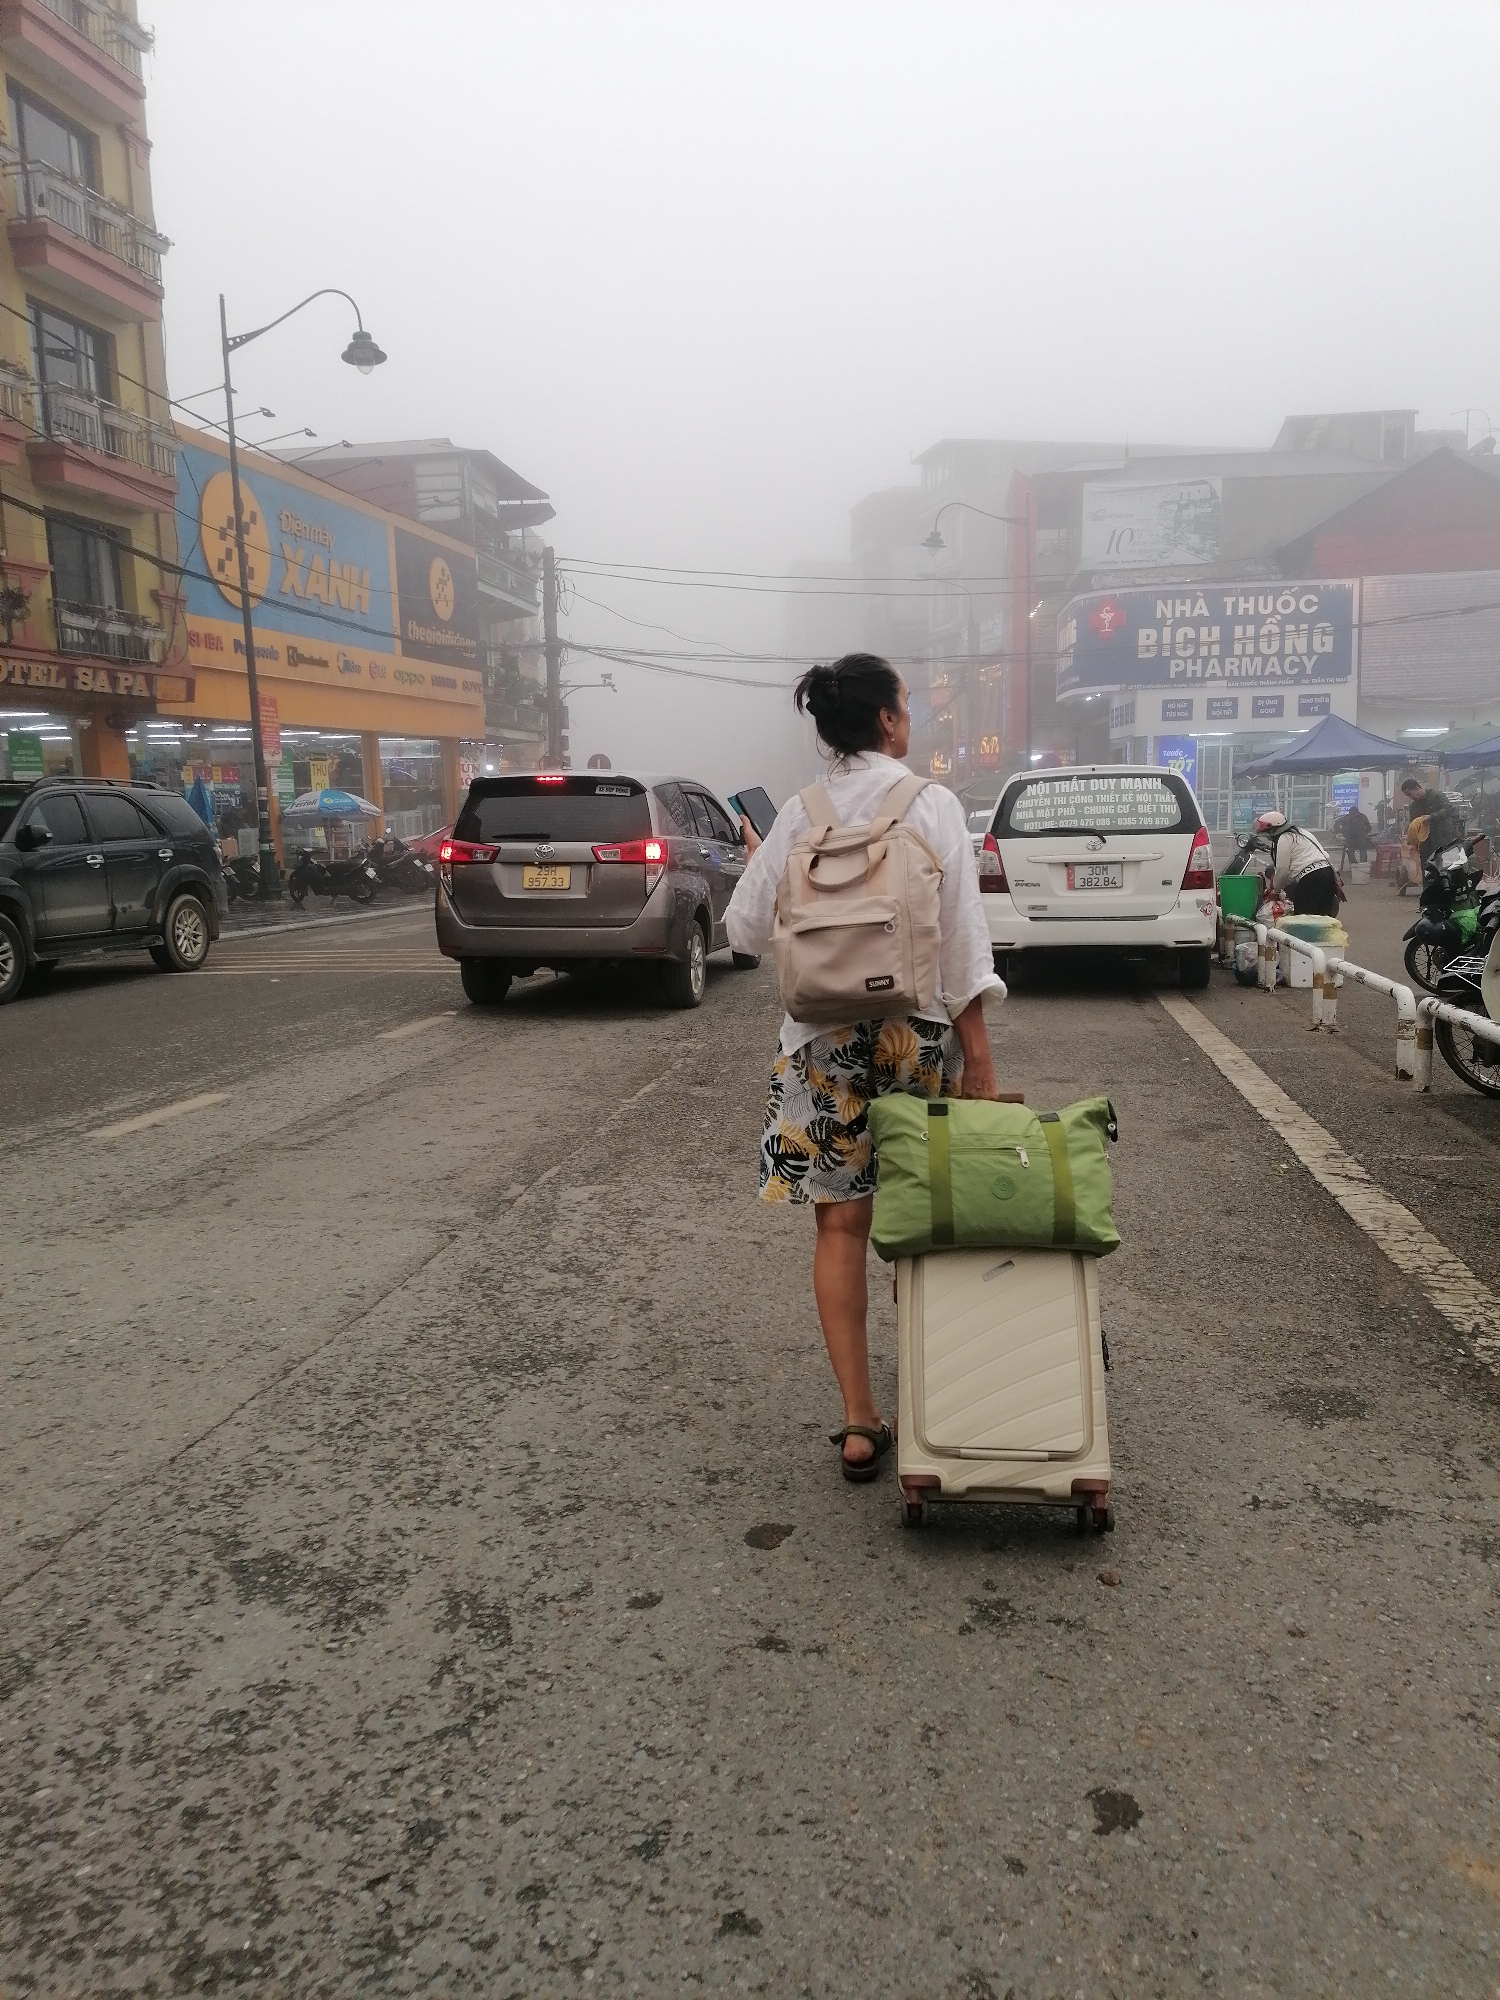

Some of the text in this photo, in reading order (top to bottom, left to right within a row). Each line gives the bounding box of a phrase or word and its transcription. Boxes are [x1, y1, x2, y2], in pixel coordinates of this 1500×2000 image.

[280, 543, 371, 614] XANH
[1156, 586, 1319, 618] NHÀ THUỐC
[1138, 615, 1334, 658] BÍCH HỒNG
[1169, 655, 1319, 678] PHARMACY
[311, 763, 327, 777] THU
[1168, 754, 1195, 773] TỐT
[1026, 775, 1162, 797] NỘI THẤT DUY MẠNH
[1016, 797, 1050, 809] CHUYÊN
[1053, 796, 1067, 806] THI
[1069, 793, 1094, 804] CÔNG
[1095, 790, 1120, 803] THIẾT
[1136, 792, 1152, 803] NỘI
[1154, 791, 1176, 803] THẤT
[1016, 808, 1034, 820] NHÀ
[1058, 803, 1076, 817] PHỐ
[1084, 804, 1115, 815] CHUNG
[1117, 803, 1131, 814] CƯ
[1137, 802, 1157, 815] BIỆT
[1024, 820, 1058, 831] HOTLINE:
[1060, 819, 1078, 828] 0379
[1096, 817, 1111, 827] 086
[1118, 817, 1137, 826] 0385
[1138, 817, 1153, 826] 789
[1154, 817, 1169, 826] 870
[1088, 866, 1109, 876] 30M
[528, 877, 564, 887] 957.33
[1080, 876, 1117, 887] 382.84
[868, 978, 890, 988] SUNNY
